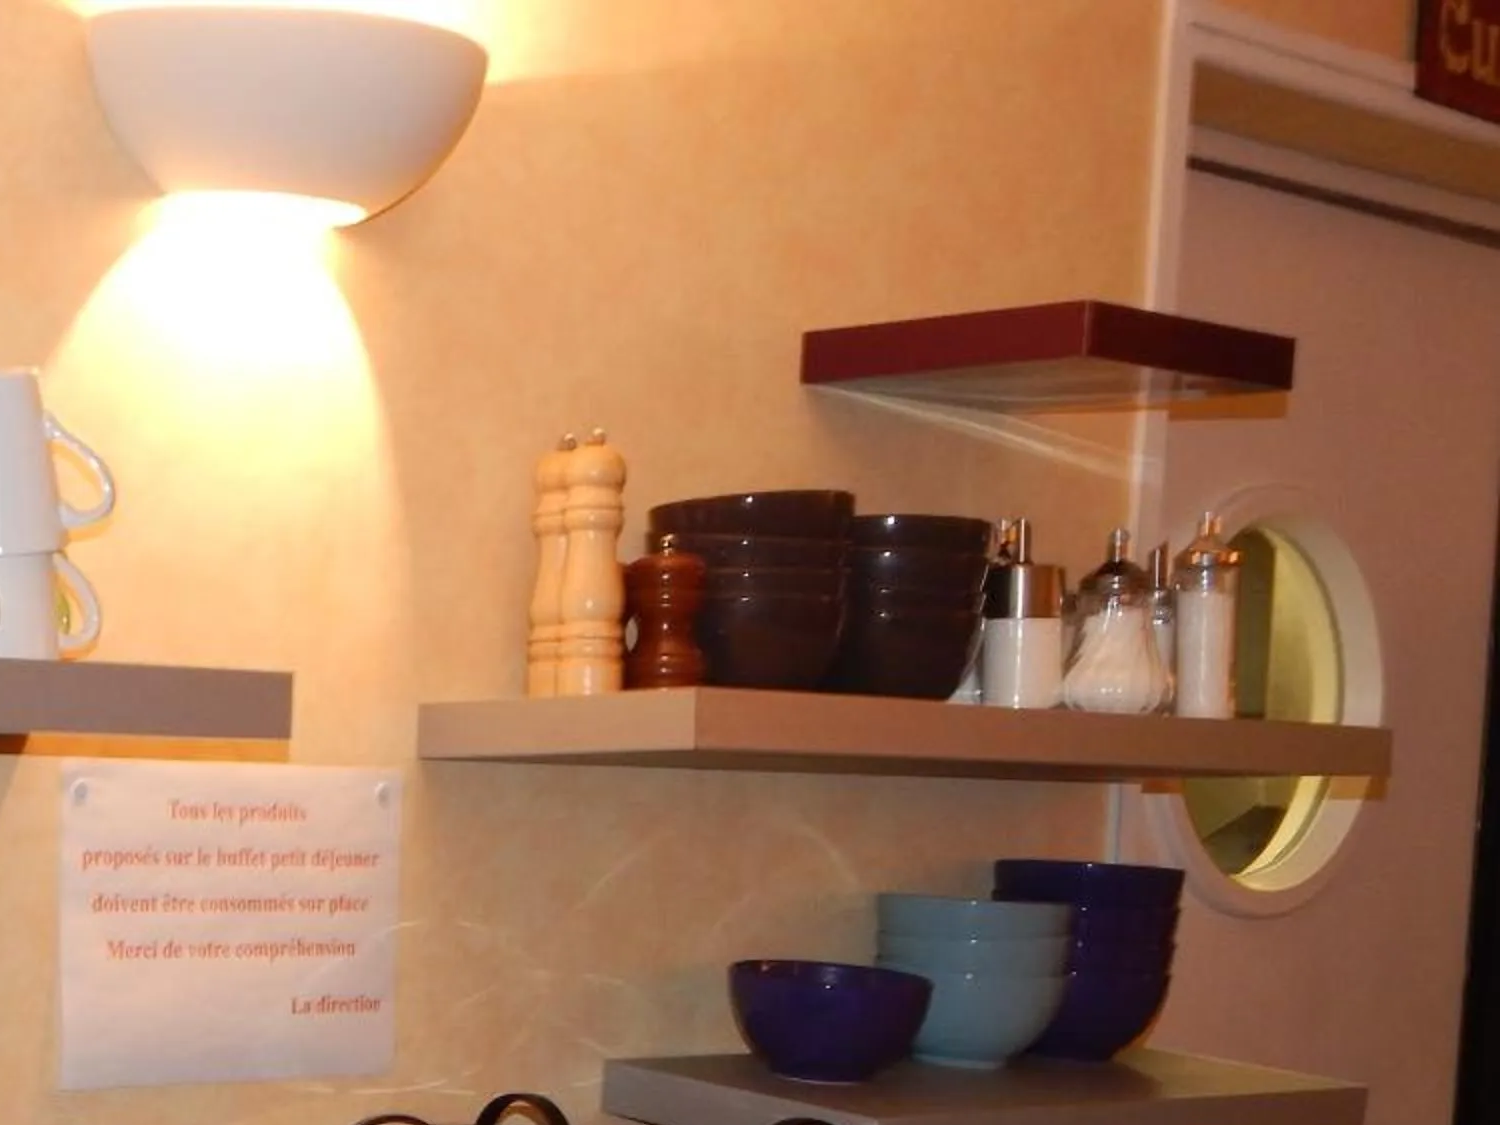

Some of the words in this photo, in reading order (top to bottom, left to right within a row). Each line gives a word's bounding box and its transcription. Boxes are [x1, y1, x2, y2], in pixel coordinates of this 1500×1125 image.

[168, 799, 207, 821] Tous
[213, 801, 233, 821] les
[239, 801, 307, 826] produits
[82, 844, 160, 872] proposés
[165, 851, 193, 866] sur
[197, 847, 211, 866] le
[217, 846, 266, 868] buffet
[270, 847, 306, 873] petit
[311, 847, 380, 872] déjeuner
[92, 892, 157, 913] doivent
[162, 892, 196, 913] être
[201, 893, 292, 914] consommés
[298, 897, 325, 913] sur
[329, 894, 369, 918] place
[106, 938, 157, 960] Merci
[163, 938, 183, 960] de
[188, 941, 232, 960] votre
[235, 937, 355, 963] compréhension
[291, 997, 311, 1014] La
[317, 993, 381, 1014] direction
